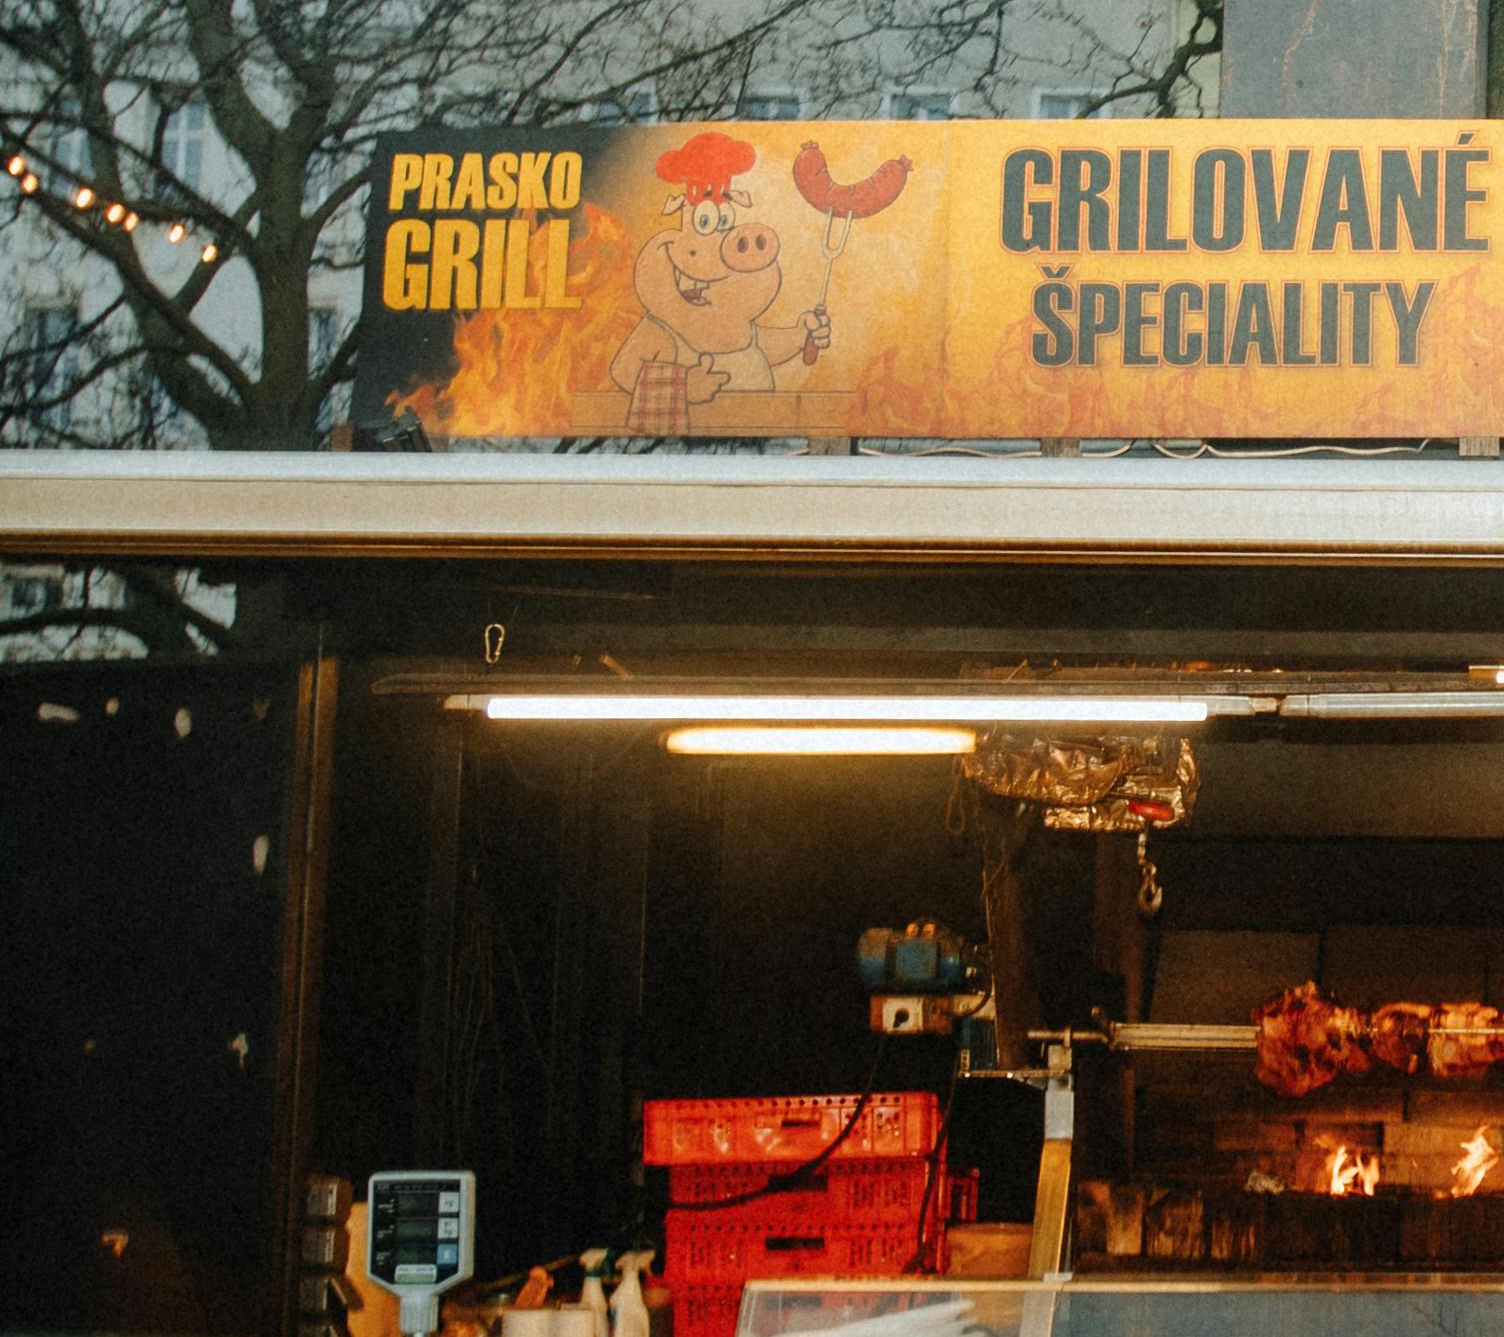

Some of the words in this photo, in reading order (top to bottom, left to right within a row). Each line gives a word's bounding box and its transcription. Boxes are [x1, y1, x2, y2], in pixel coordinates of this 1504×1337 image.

[388, 151, 583, 210] PRASKO
[999, 130, 1492, 254] GRILOVANÉ
[383, 218, 582, 310] GRILL
[1031, 264, 1436, 367] ŠPECIALITY
